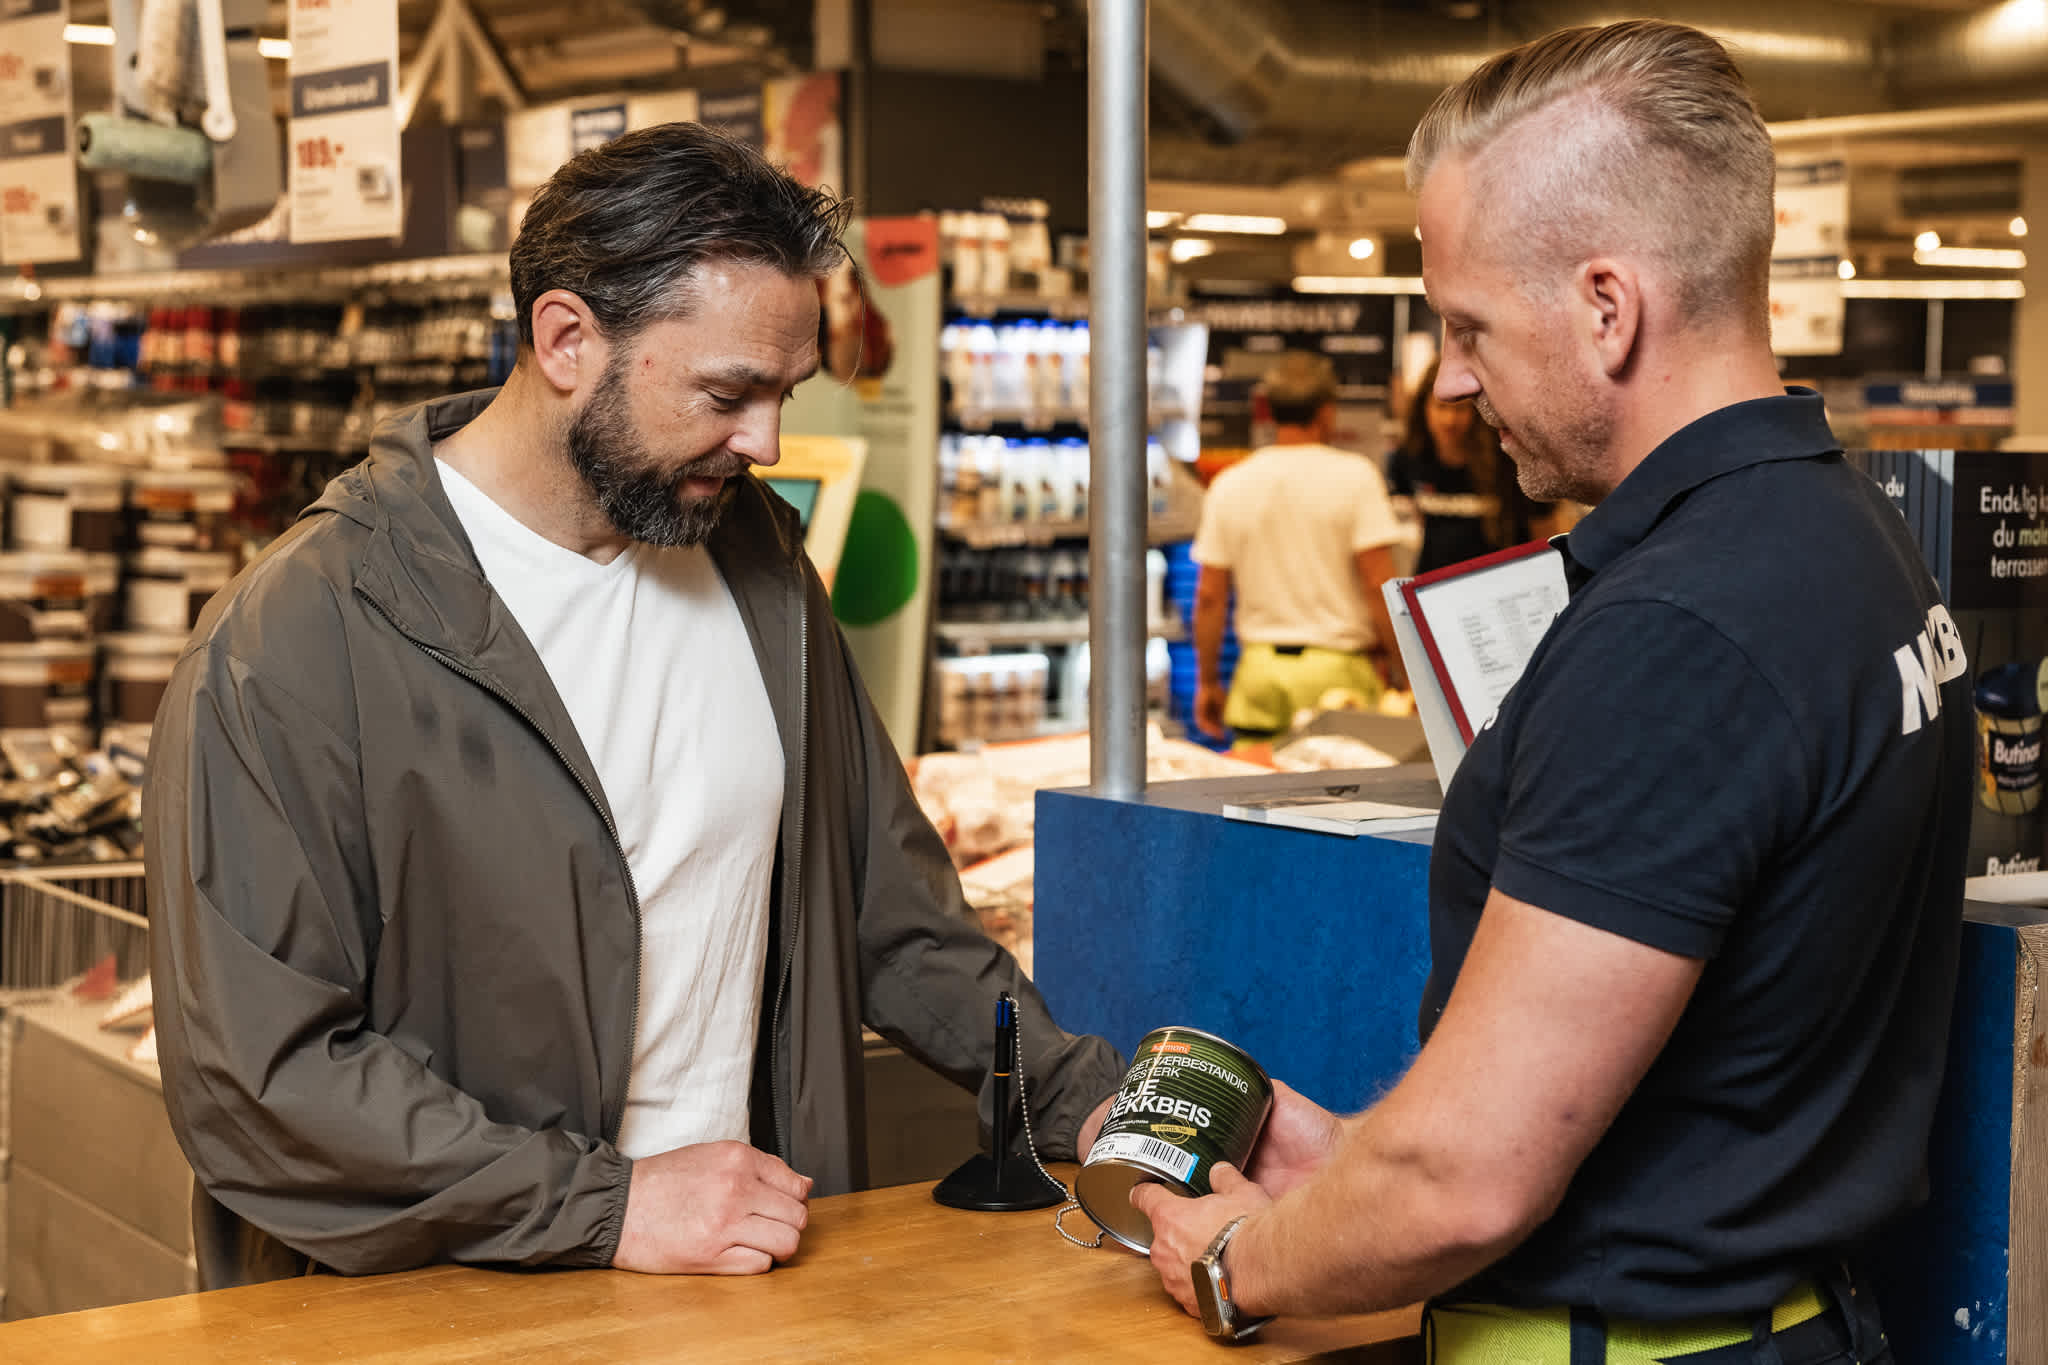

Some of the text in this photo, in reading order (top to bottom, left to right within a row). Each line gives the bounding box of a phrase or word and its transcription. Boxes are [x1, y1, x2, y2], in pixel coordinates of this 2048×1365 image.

[1992, 519, 2015, 548] du
[1153, 1056, 1250, 1095] VÆRBESTANDIG
[1102, 1095, 1213, 1128] DEKKBEIS
